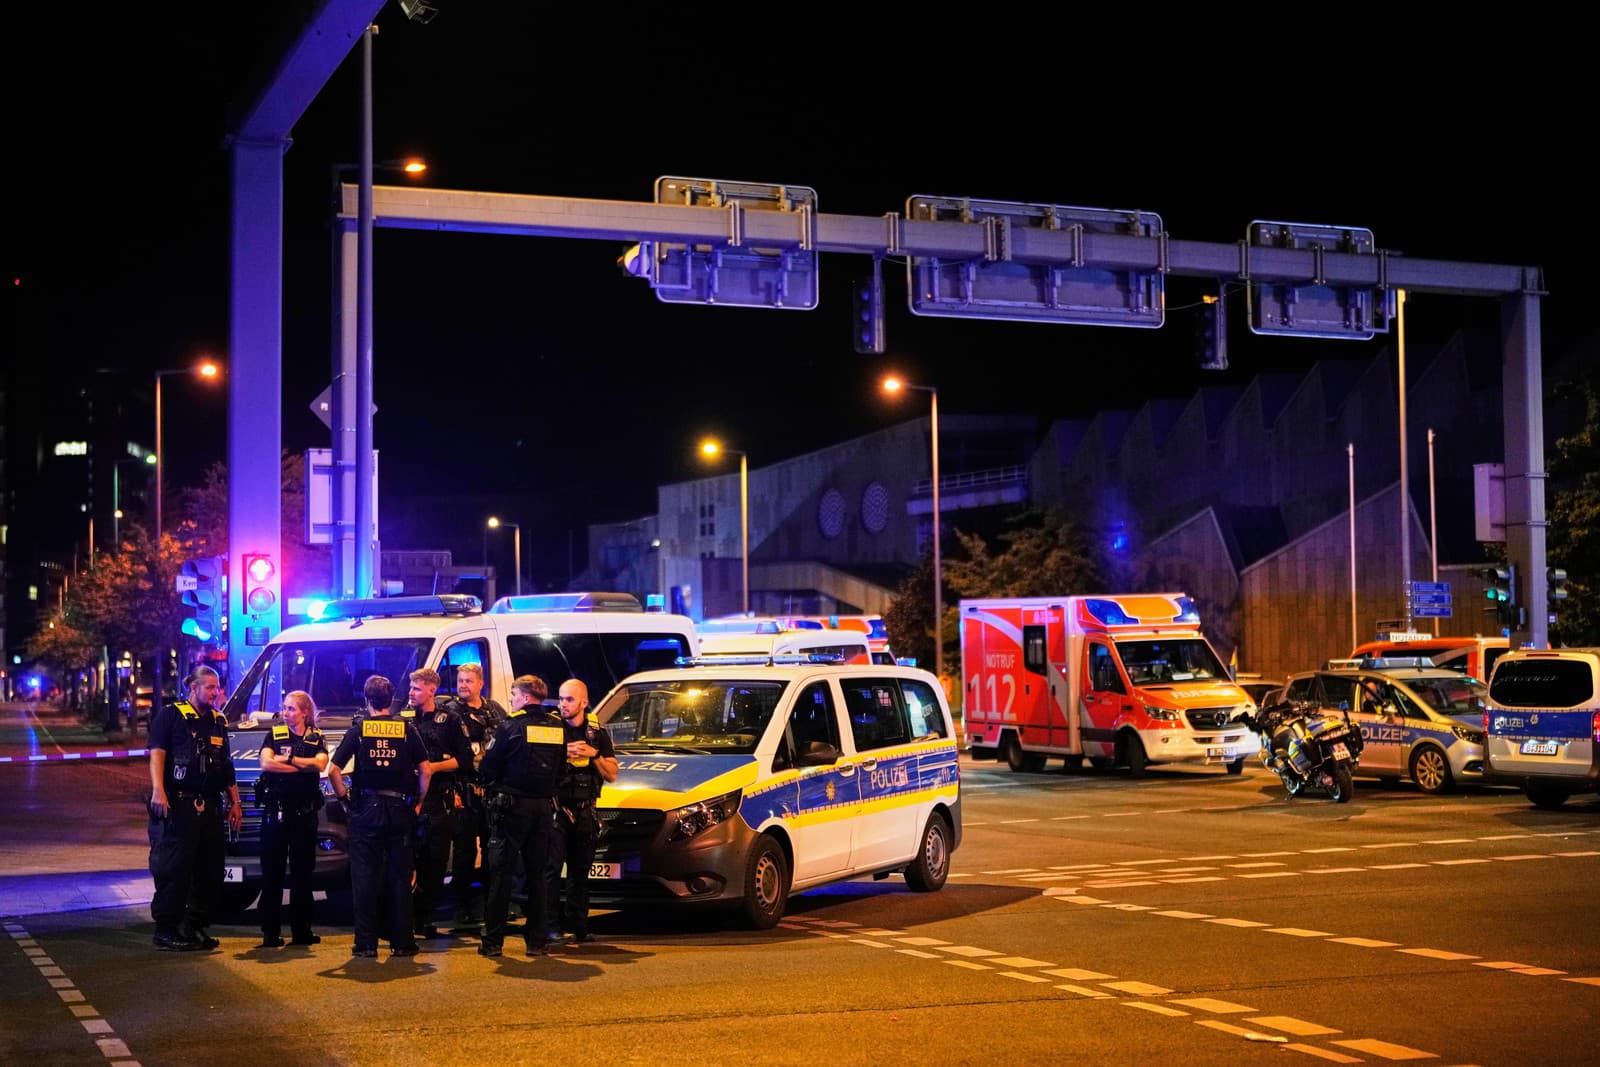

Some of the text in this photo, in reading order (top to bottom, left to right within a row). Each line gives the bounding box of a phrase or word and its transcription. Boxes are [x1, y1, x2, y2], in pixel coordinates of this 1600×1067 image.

[985, 654, 1016, 669] NOTRUF
[970, 673, 1017, 721] 112
[365, 722, 403, 736] POLIZEI
[1494, 717, 1525, 730] POLIZEI
[1360, 726, 1403, 741] OLIZEI
[376, 739, 389, 749] BE
[369, 749, 397, 758] D1229
[617, 761, 678, 772] LIZEI
[871, 763, 909, 790] POLIZEI
[590, 864, 611, 877] 822
